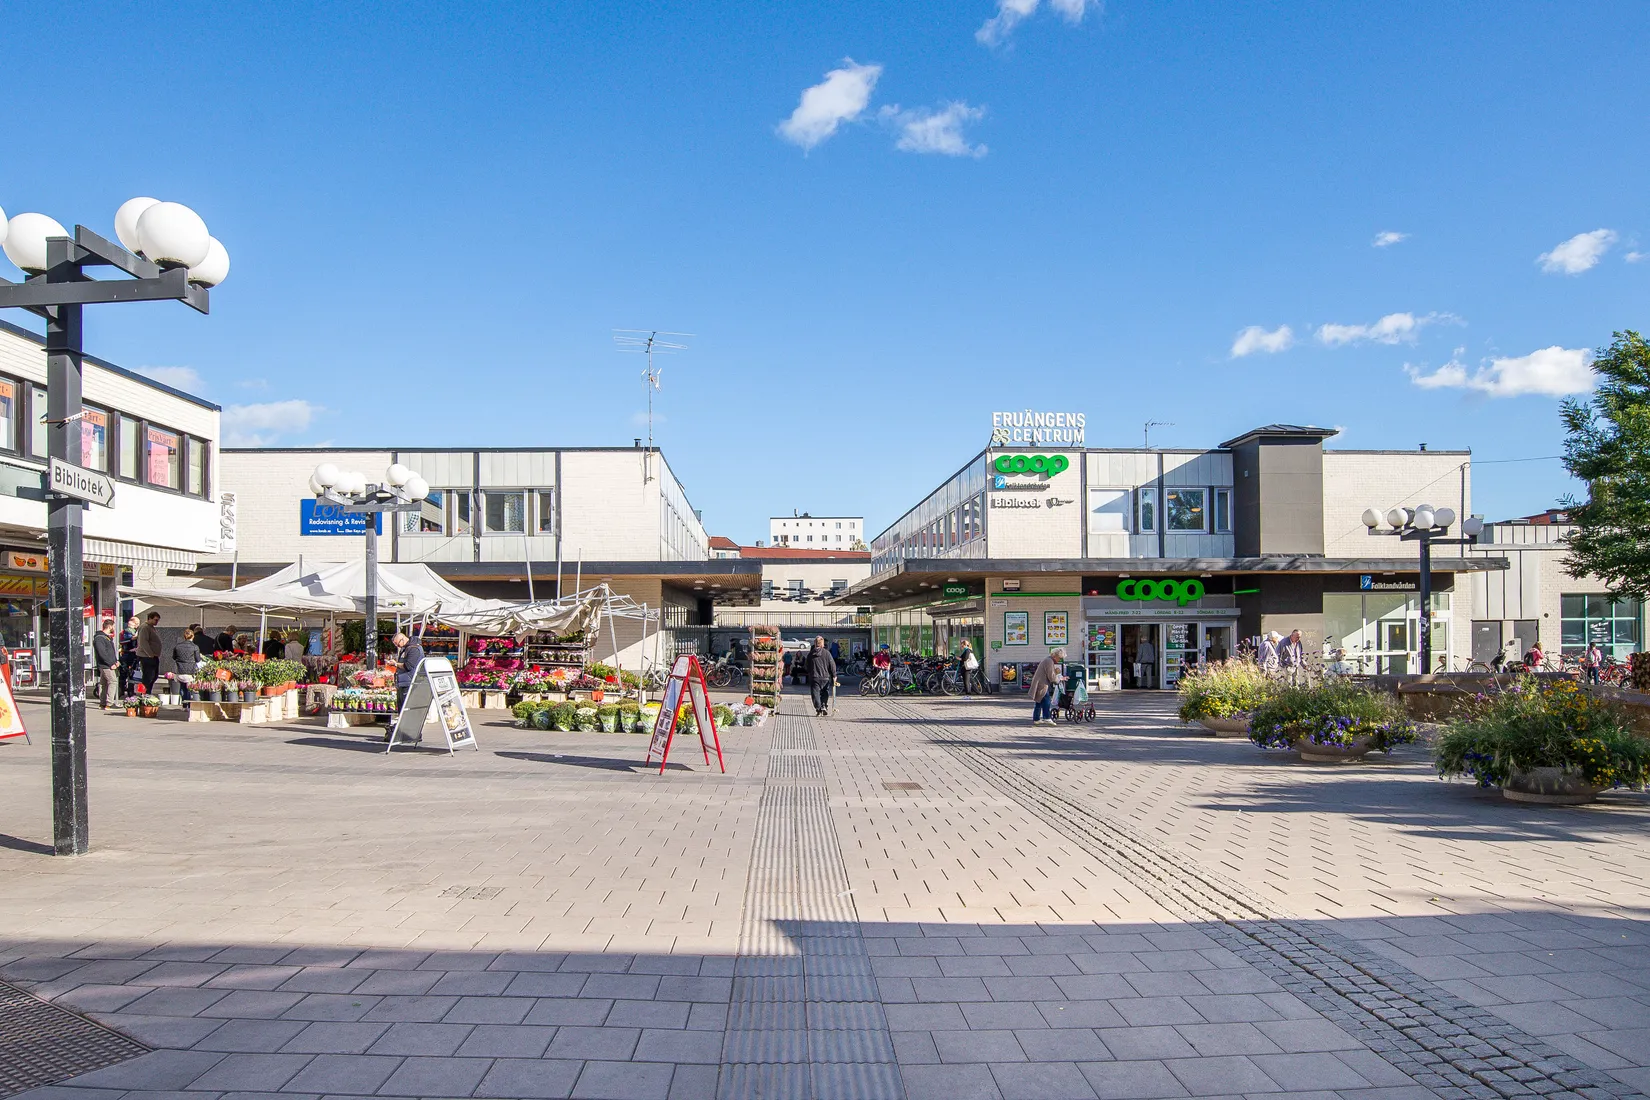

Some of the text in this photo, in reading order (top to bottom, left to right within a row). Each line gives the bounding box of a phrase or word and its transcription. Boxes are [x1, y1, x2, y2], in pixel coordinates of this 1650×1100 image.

[1013, 428, 1085, 442] CENTRUM
[995, 454, 1069, 477] coop
[55, 465, 104, 497] Bibliotek
[308, 518, 344, 526] Redovisning
[1116, 579, 1205, 606] coop
[1371, 581, 1416, 589] Folktandvården
